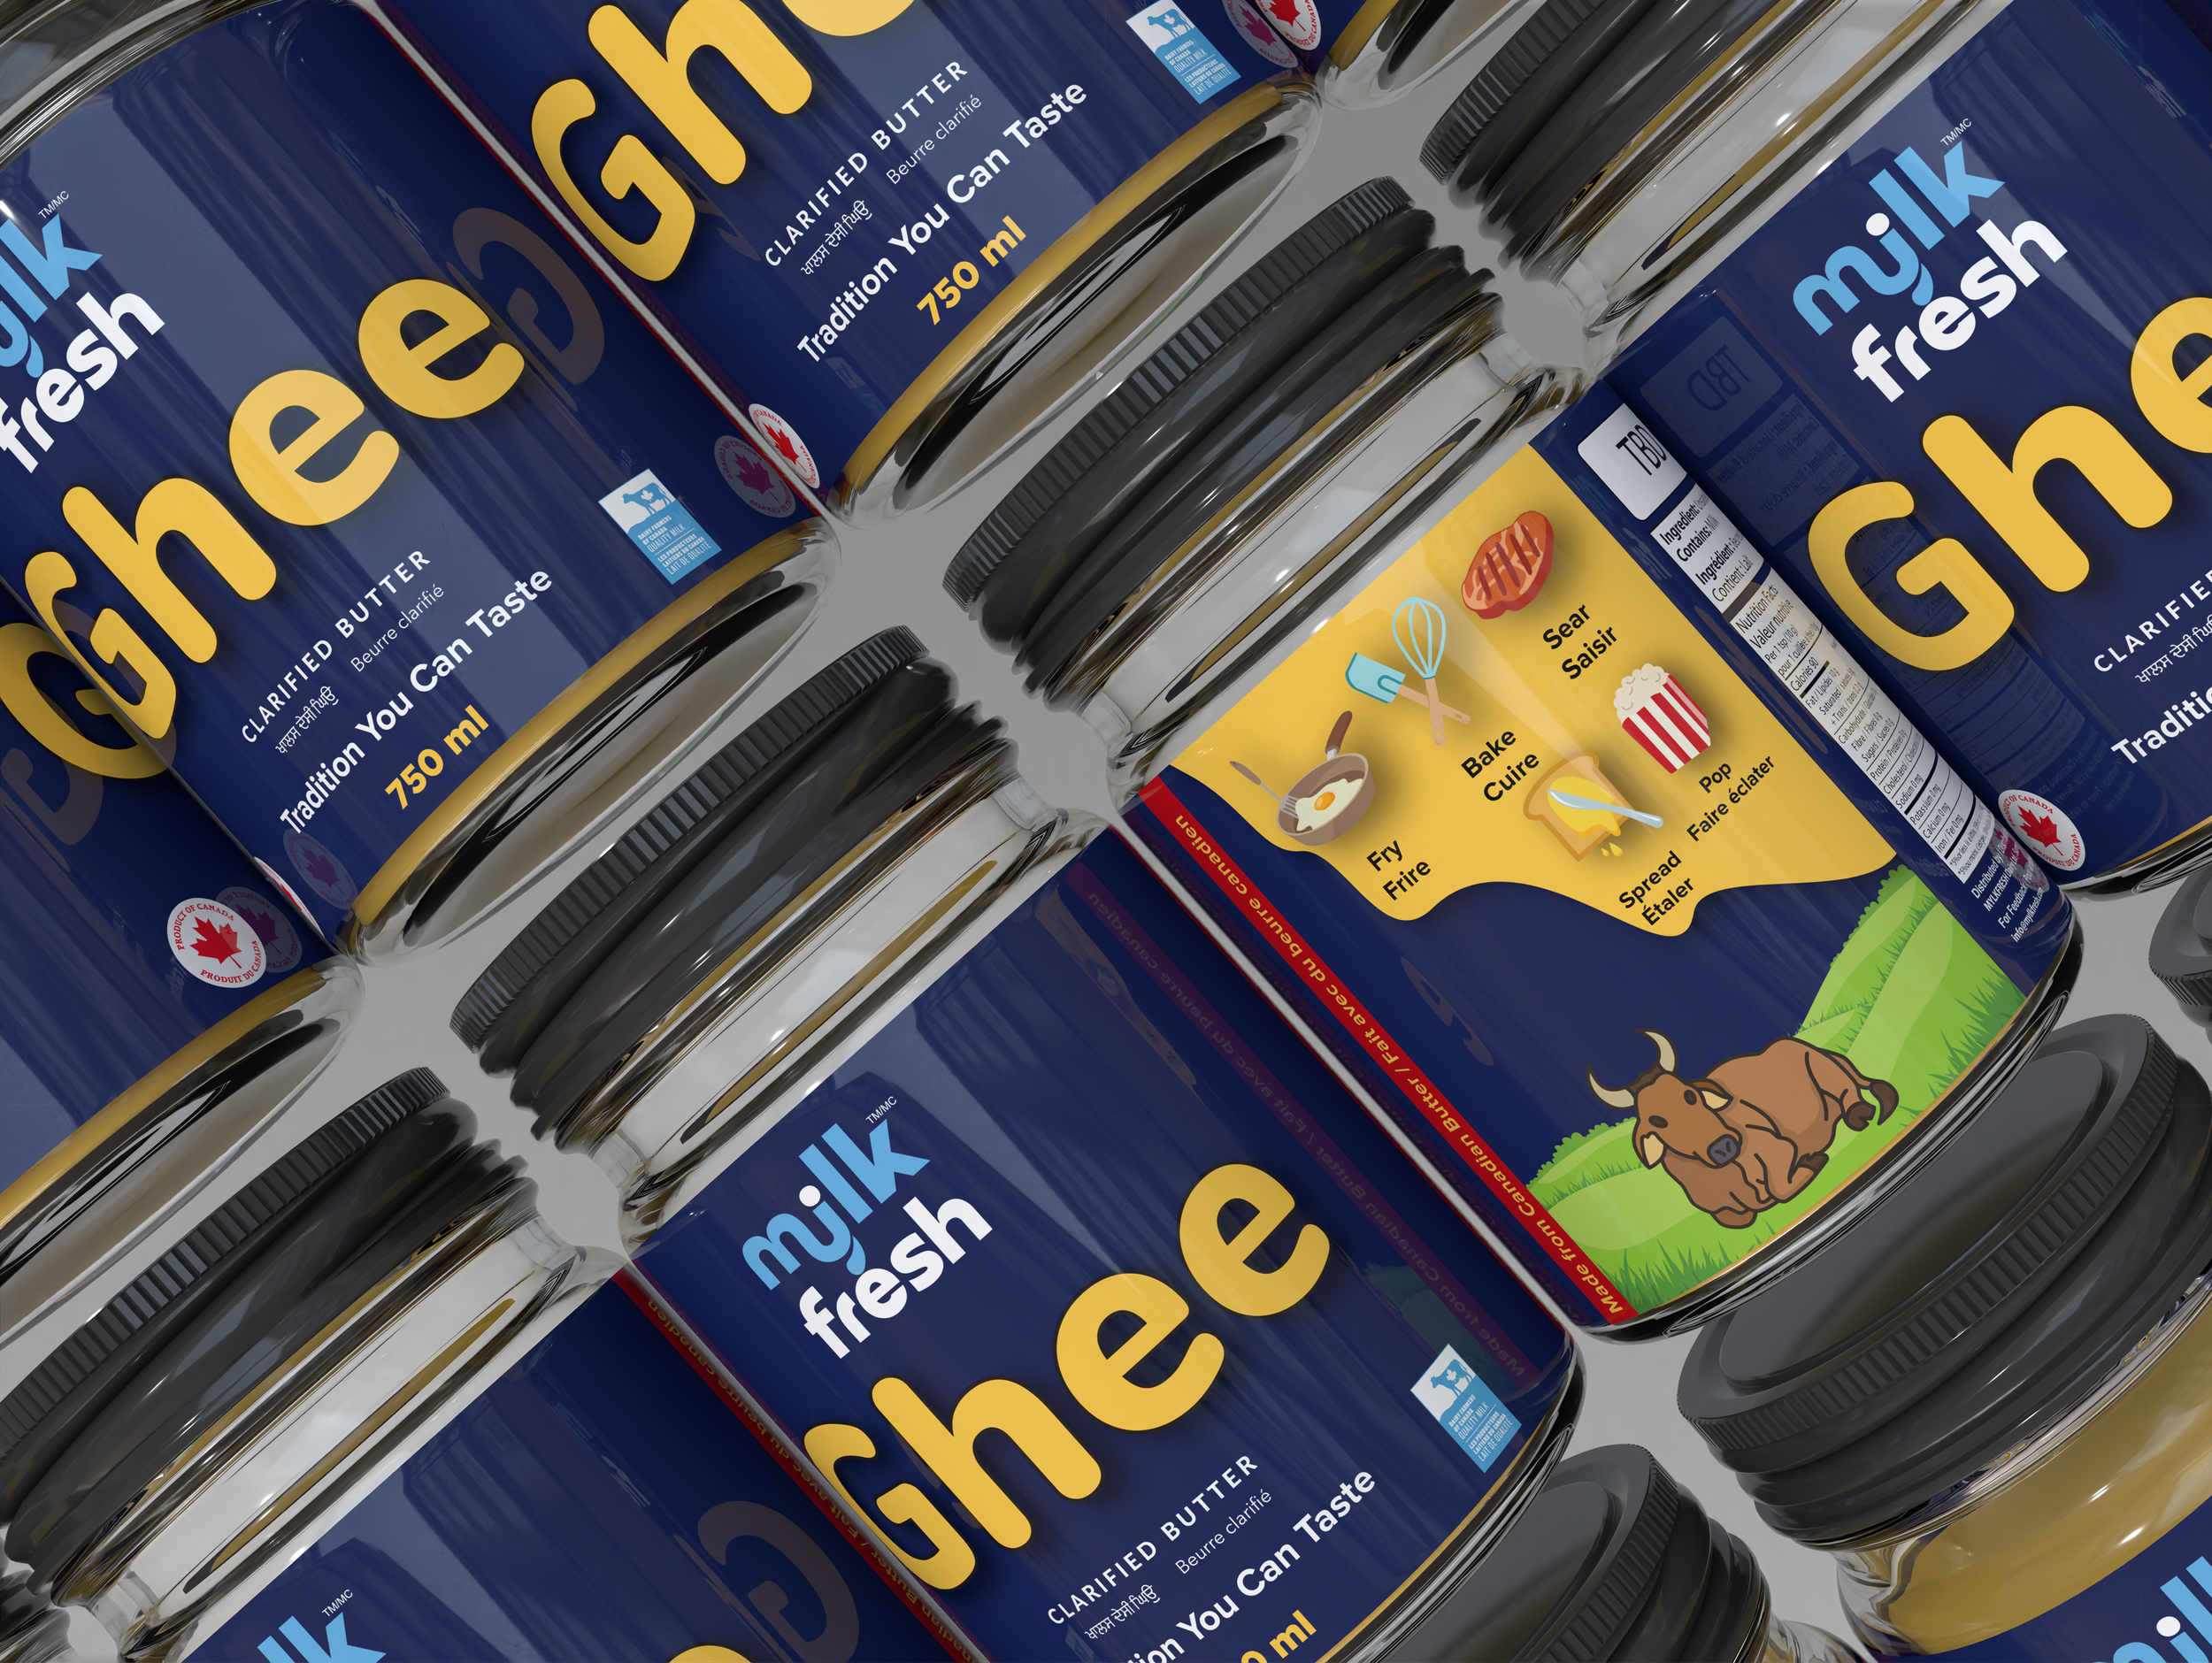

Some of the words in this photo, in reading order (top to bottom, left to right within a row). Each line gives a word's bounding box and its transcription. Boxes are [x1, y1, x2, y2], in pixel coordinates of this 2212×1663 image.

[532, 0, 914, 281] Gh
[886, 140, 934, 184] Beurre
[936, 95, 981, 139] clarifié
[1940, 119, 1971, 146] TM/MC
[765, 153, 867, 265] CLARIFIED
[872, 62, 967, 149] BUTTER
[38, 191, 69, 218] TM/MC
[797, 257, 897, 362] Tradition
[887, 203, 950, 255] You
[947, 149, 1010, 203] Can
[1002, 85, 1087, 148] Taste
[917, 261, 979, 326] 750
[979, 215, 1026, 267] ml
[1852, 219, 2067, 402] fresh
[0, 292, 165, 473] fresh
[1616, 425, 1667, 476] TBD
[1809, 297, 2212, 671] Ghe
[25, 280, 524, 739] Ghee
[1659, 504, 1701, 545] Ingredient:
[647, 533, 672, 552] QUALITY
[670, 524, 686, 536] MILK
[1677, 521, 1712, 562] Contains:
[666, 561, 681, 575] LAIT
[680, 556, 690, 565] DE
[350, 629, 397, 672] Beurre
[398, 584, 444, 629] clarifié
[1543, 604, 1590, 649] Sear
[1735, 598, 1769, 633] Nutrition
[1762, 585, 1778, 602] Facts
[1749, 621, 1777, 648] Valeur
[1772, 600, 1793, 626] nutritive
[242, 640, 332, 742] CLARIFIED
[335, 551, 430, 638] BUTTER
[1562, 626, 1617, 679] Saisir
[1764, 650, 1778, 663] Per
[1778, 639, 1788, 649] tsp
[1778, 659, 1792, 678] pour
[1790, 665, 1814, 691] Calories
[1809, 656, 1818, 669] 90
[280, 742, 365, 833] Tradition
[355, 692, 413, 741] You
[411, 639, 472, 692] Can
[465, 571, 552, 637] Taste
[1805, 695, 1817, 709] Fat
[1819, 688, 1841, 715] Saturated
[1851, 735, 1866, 751] Fibre
[1862, 742, 1878, 763] Sugars
[1877, 724, 1890, 741] Sucres
[2110, 686, 2212, 763] Traditi
[385, 749, 443, 809] 750
[443, 704, 488, 755] ml
[1461, 732, 1517, 778] Bake
[1870, 759, 1889, 780] Protein
[1884, 761, 1908, 794] Cholesterol
[1484, 755, 1540, 801] Cuire
[1686, 803, 1729, 841] Faire
[1729, 756, 1774, 803] éclater
[1699, 763, 1731, 793] Pop
[1895, 786, 1915, 809] Sodium
[1909, 795, 1933, 825] Potassium
[1923, 815, 1942, 839] Calcium
[1176, 816, 1247, 894] canadien
[1366, 840, 1402, 871] Fry
[1935, 839, 1947, 853] Iron
[1946, 825, 1955, 838] Fer
[1382, 862, 1431, 900] Frire
[1619, 850, 1682, 908] Spread
[1641, 877, 1694, 925] Étaler
[1971, 859, 1999, 899] Distributed
[1984, 873, 2009, 911] MYLKFRESH
[173, 910, 187, 950] PRODUCT
[185, 905, 196, 914] OF
[196, 903, 234, 921] CANADA
[1249, 898, 1302, 957] beurre
[1998, 912, 2011, 929] For
[200, 969, 242, 984] PRODUIT
[242, 969, 254, 980] DU
[251, 940, 261, 972] CANADA
[1302, 958, 1325, 981] du
[1326, 985, 1365, 1025] avec
[1365, 1028, 1399, 1064] Fait
[865, 1096, 896, 1123] TM/MC
[1408, 1078, 1460, 1132] Butter
[1461, 1134, 1535, 1216] Canadian
[1537, 1220, 1576, 1261] from
[800, 1197, 993, 1359] fresh
[1577, 1253, 1624, 1314] Made
[804, 1164, 1330, 1590] Ghee
[1458, 1414, 1479, 1439] QUALITY
[1475, 1402, 1488, 1418] MILK
[1478, 1446, 1491, 1461] LAIT
[1487, 1438, 1497, 1450] DE
[1048, 1542, 1156, 1624] CLARIFIED
[1160, 1456, 1257, 1541] BUTTER
[1175, 1534, 1225, 1574] Beurre
[1226, 1489, 1271, 1534] clarifié
[1176, 1595, 1240, 1640] You
[1237, 1544, 1301, 1596] Can
[1293, 1472, 1375, 1543] Taste
[322, 1590, 353, 1616] TM/MC
[1269, 1610, 1317, 1659] ml
